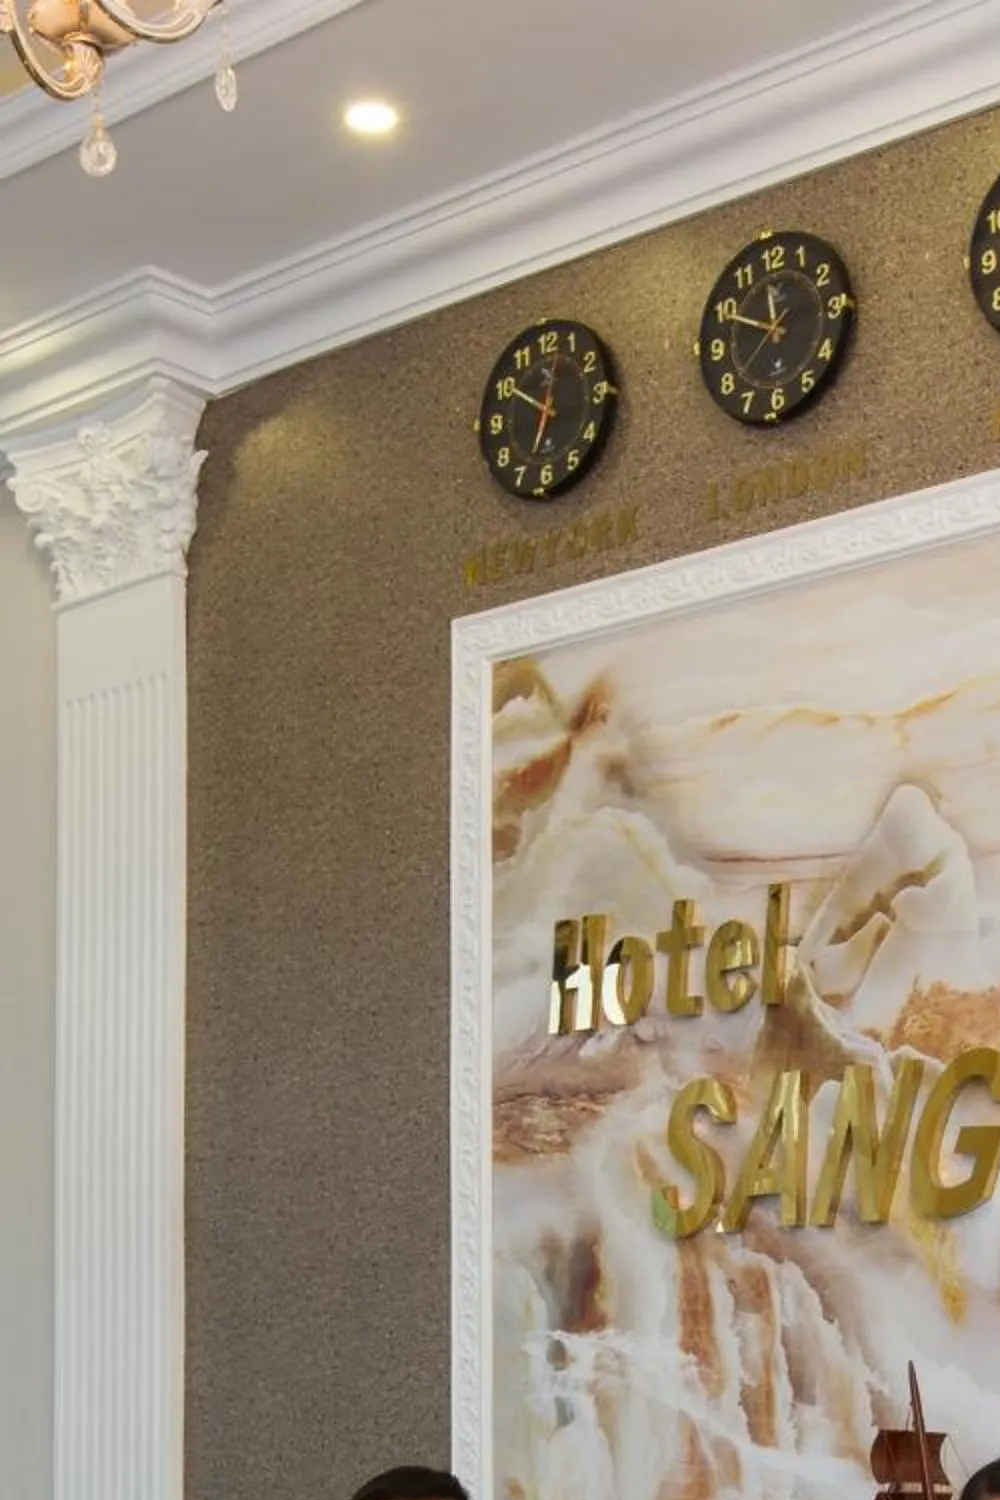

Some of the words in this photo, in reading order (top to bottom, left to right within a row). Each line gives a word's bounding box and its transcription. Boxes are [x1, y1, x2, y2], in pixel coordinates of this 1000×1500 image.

[761, 245, 785, 272] 12
[796, 246, 805, 267] 1
[981, 249, 996, 275] 9
[735, 264, 752, 288] 11
[816, 263, 829, 287] 2
[714, 297, 736, 323] 10
[828, 296, 840, 319] 3
[538, 332, 558, 353] 12
[568, 332, 575, 352] 1
[711, 338, 724, 361] 9
[818, 337, 833, 362] 4
[513, 346, 530, 369] 11
[583, 352, 596, 372] 2
[496, 376, 515, 401] 10
[721, 373, 735, 395] 8
[801, 369, 814, 393] 5
[741, 391, 755, 414] 7
[771, 388, 784, 410] 6
[490, 415, 503, 435] 9
[583, 420, 595, 442] 4
[498, 448, 509, 467] 8
[568, 449, 579, 471] 5
[514, 465, 526, 487] 7
[541, 465, 552, 485] 6
[548, 883, 790, 1036] Hotel
